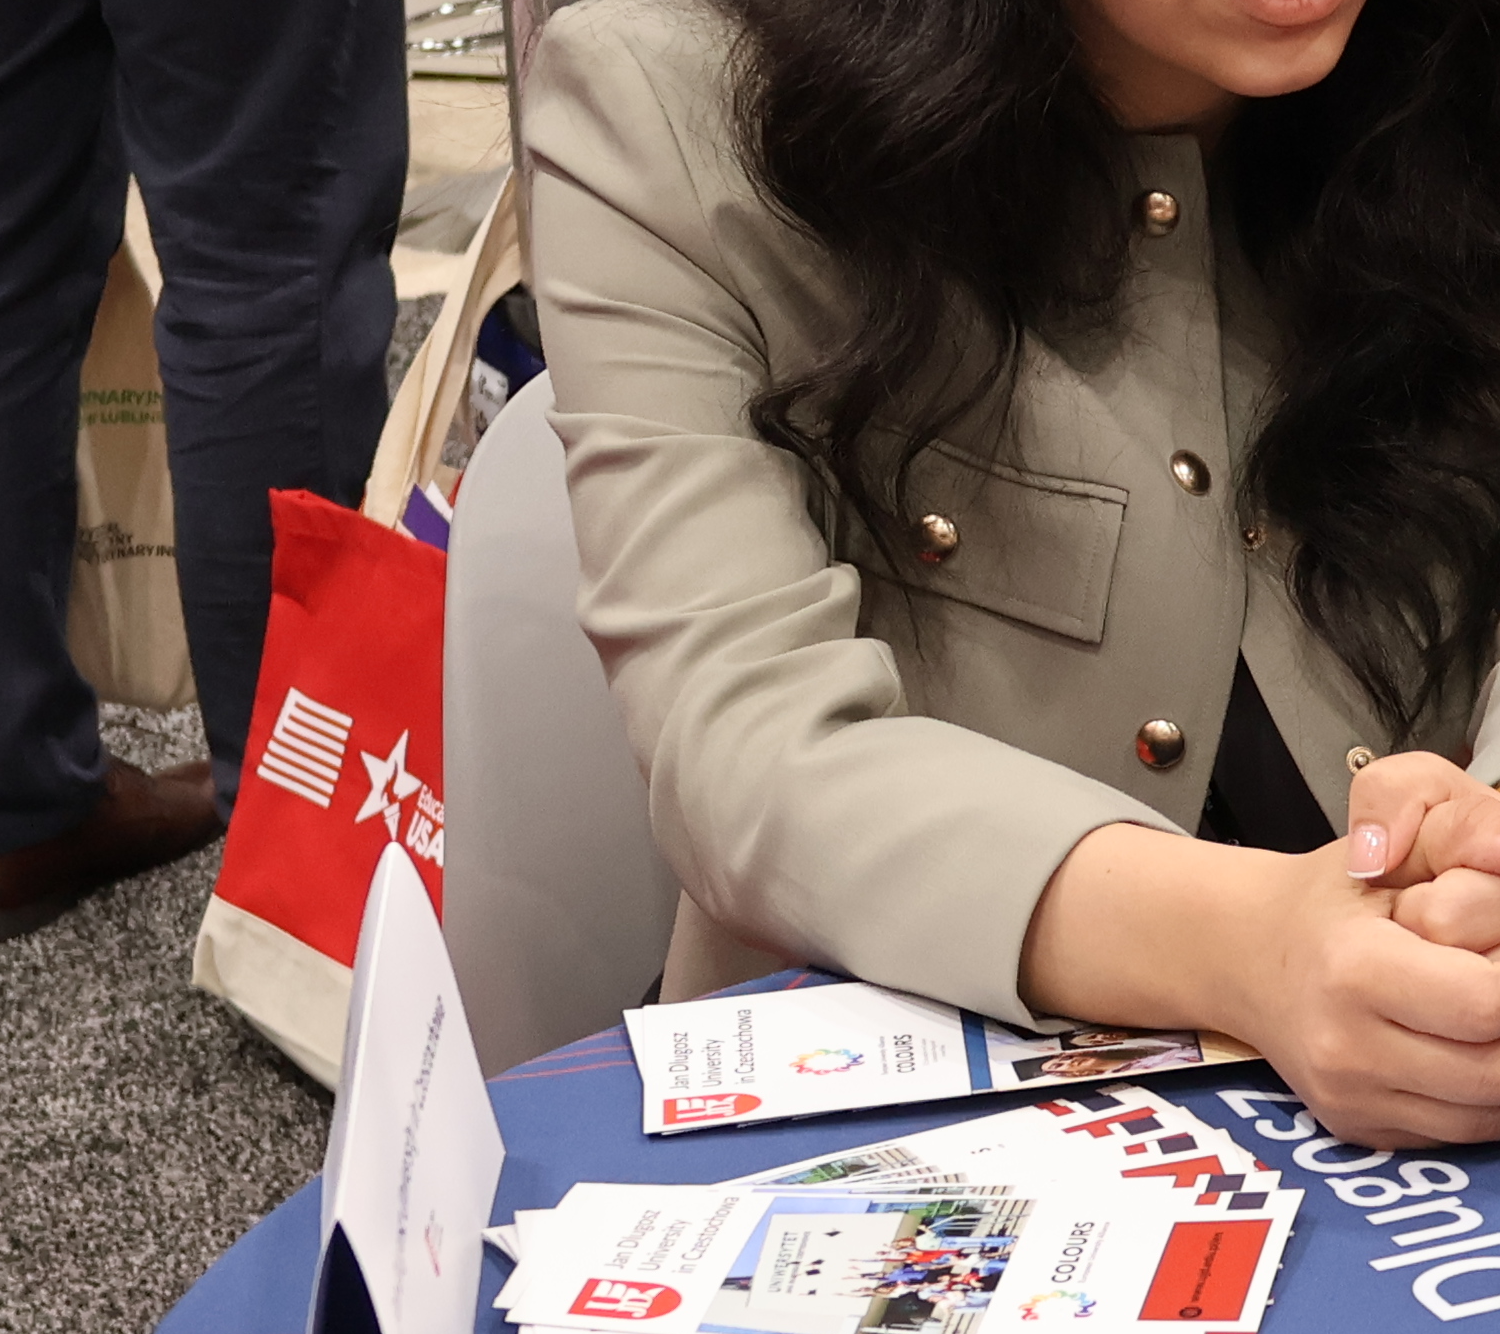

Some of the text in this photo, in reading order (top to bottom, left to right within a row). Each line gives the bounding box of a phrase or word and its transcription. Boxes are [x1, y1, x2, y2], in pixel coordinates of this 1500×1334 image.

[701, 1039, 725, 1088] University
[893, 1034, 915, 1073] COLOURS
[669, 1073, 689, 1090] Jan
[734, 1075, 755, 1085] in
[638, 1219, 693, 1271] University
[1051, 1222, 1095, 1283] COLOURS
[604, 1252, 633, 1269] Jan
[672, 1264, 697, 1274] in
